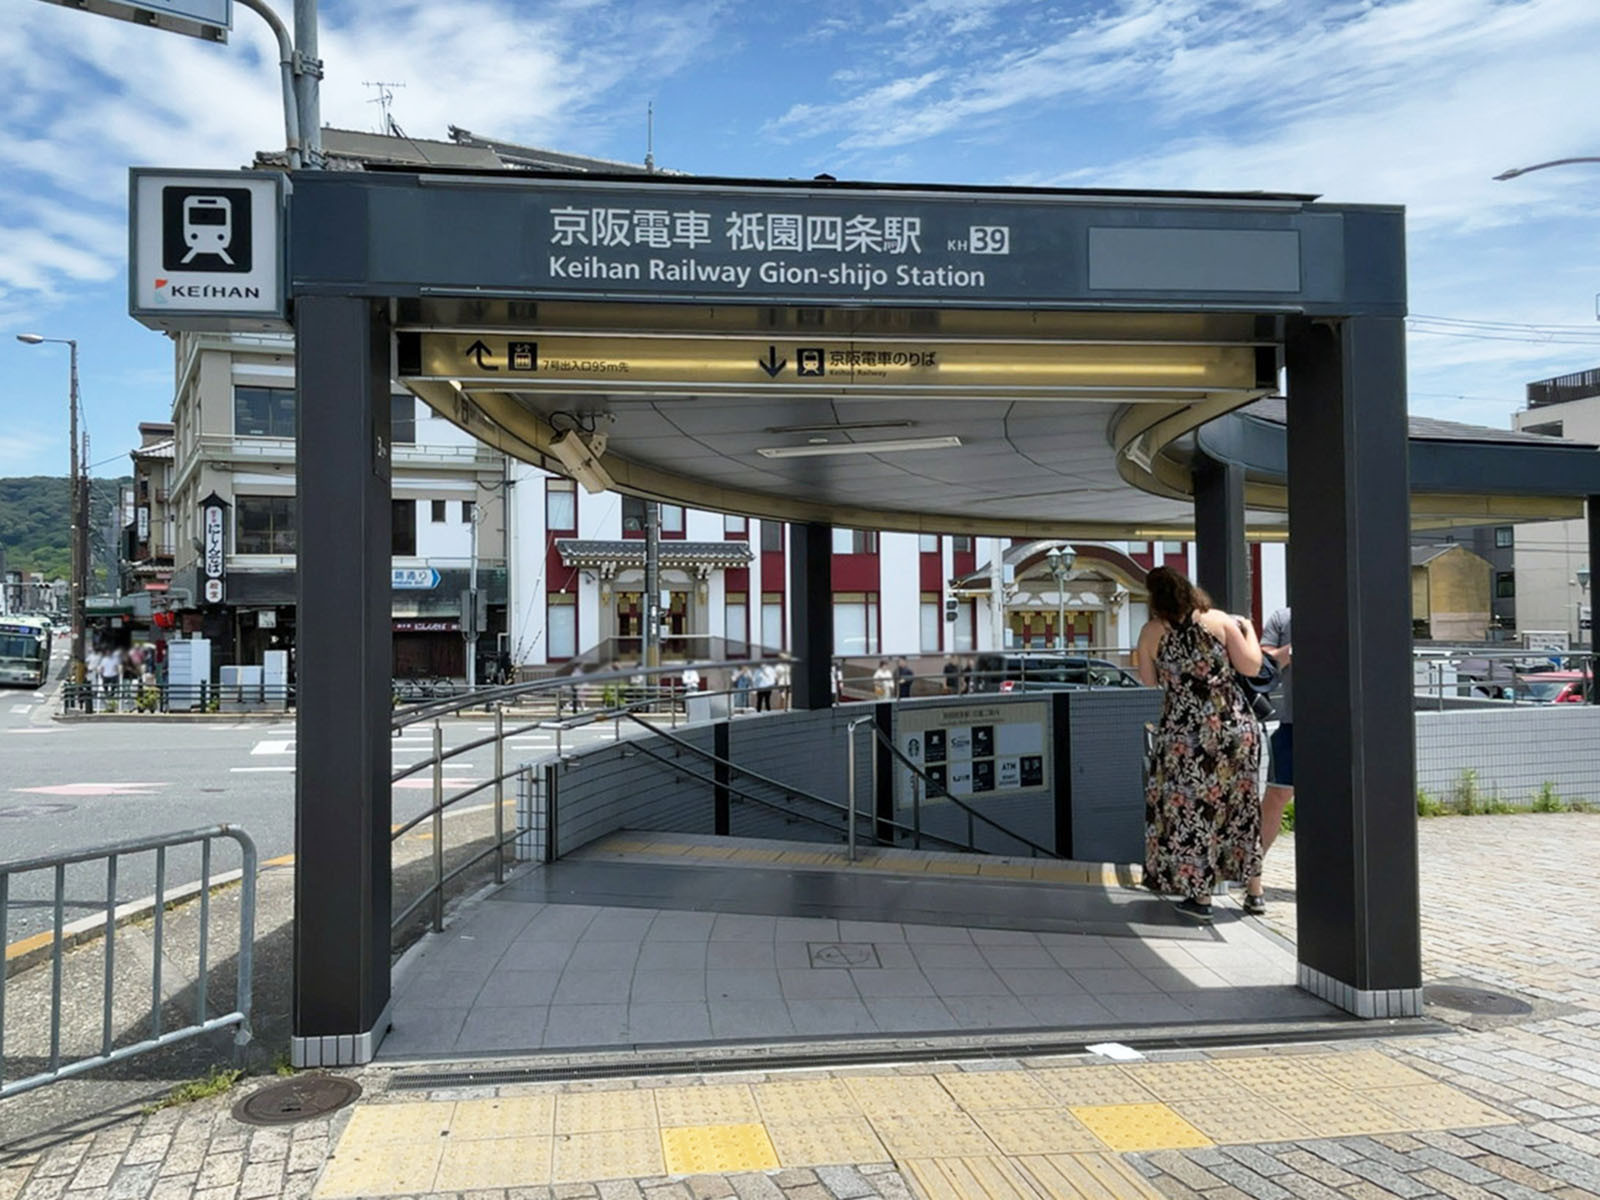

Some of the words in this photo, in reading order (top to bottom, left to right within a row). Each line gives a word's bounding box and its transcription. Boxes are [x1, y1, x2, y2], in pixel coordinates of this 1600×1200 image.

[550, 206, 711, 249] 京阪電車
[947, 239, 967, 251] KH
[972, 227, 1007, 252] 39
[550, 256, 640, 280] Keihan
[650, 259, 751, 288] Railway
[759, 261, 888, 291] Gion-shijo
[896, 265, 985, 287] Station
[171, 285, 259, 299] KEIHAN
[543, 360, 629, 373] 7号出入口95m先
[829, 351, 936, 367] 京阪電車のりば
